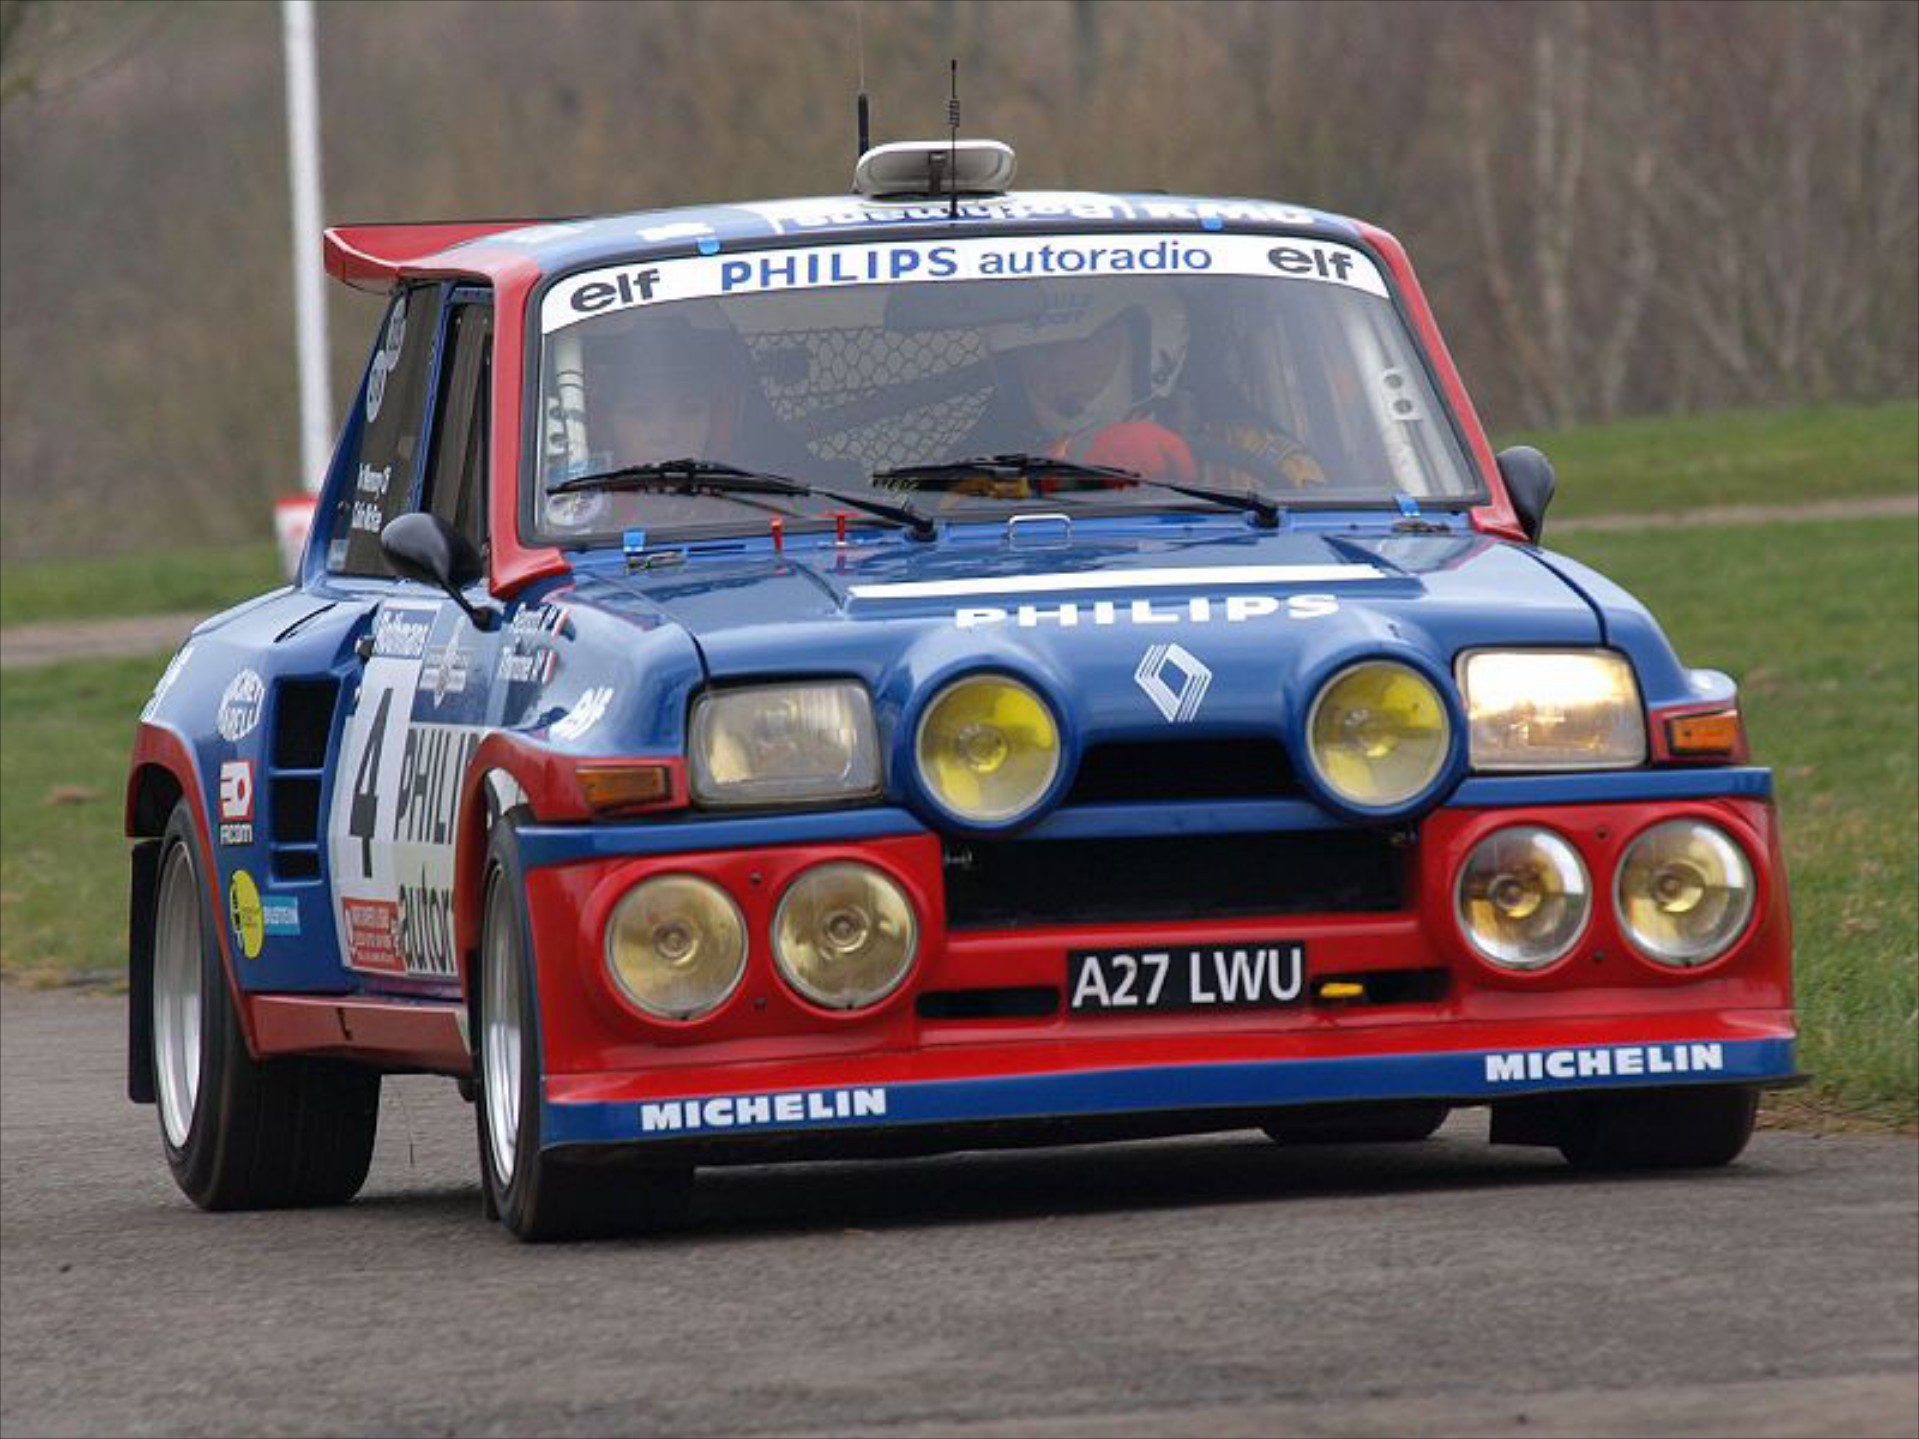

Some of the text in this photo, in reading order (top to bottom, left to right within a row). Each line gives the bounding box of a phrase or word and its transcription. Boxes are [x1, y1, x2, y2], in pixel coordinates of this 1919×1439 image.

[721, 240, 1213, 291] PHILIPS autoradio
[1267, 246, 1354, 282] elf
[570, 267, 661, 313] elf
[954, 594, 1341, 629] PHILIPS
[349, 687, 394, 879] 4
[1070, 946, 1303, 1010] A27 LWU
[1485, 1043, 1724, 1082] MICHELIN
[641, 1087, 887, 1132] MICHELIN
